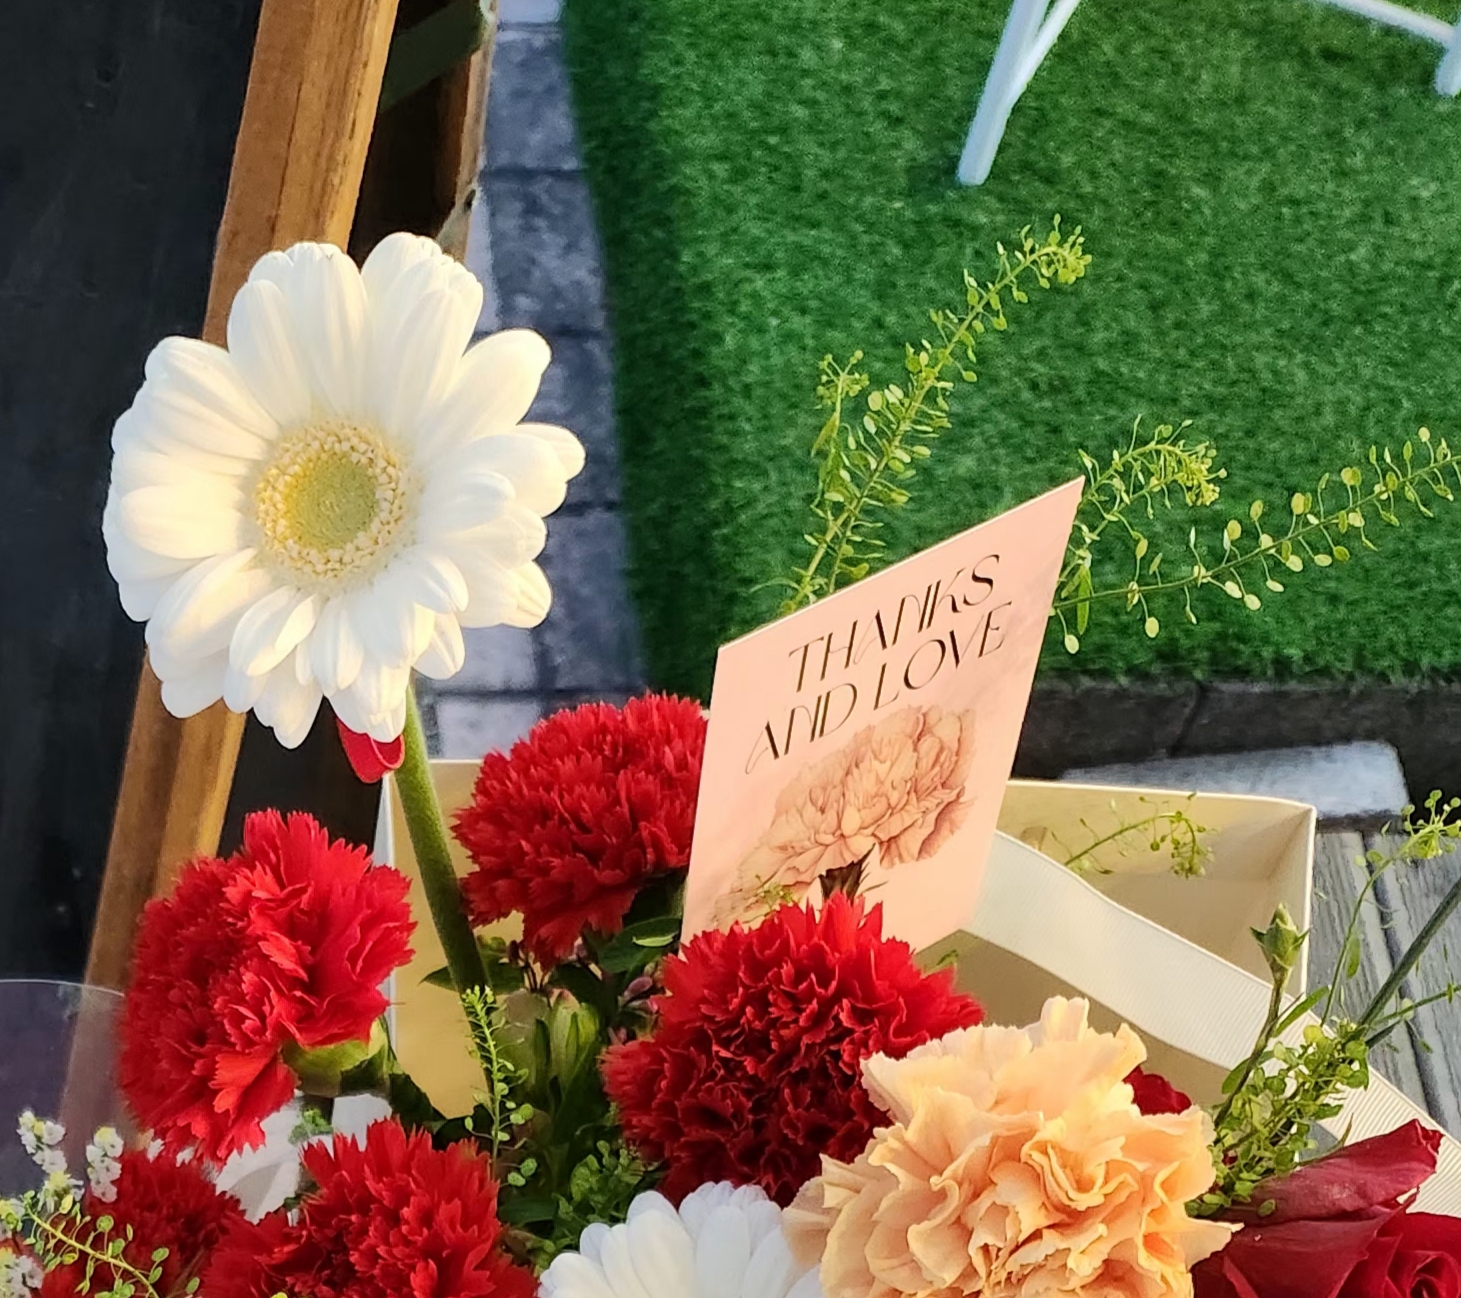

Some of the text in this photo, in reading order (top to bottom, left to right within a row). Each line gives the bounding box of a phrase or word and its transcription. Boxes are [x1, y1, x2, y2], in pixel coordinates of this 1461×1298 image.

[745, 600, 1013, 775] AND LOVE
[788, 553, 1001, 694] THANKS
